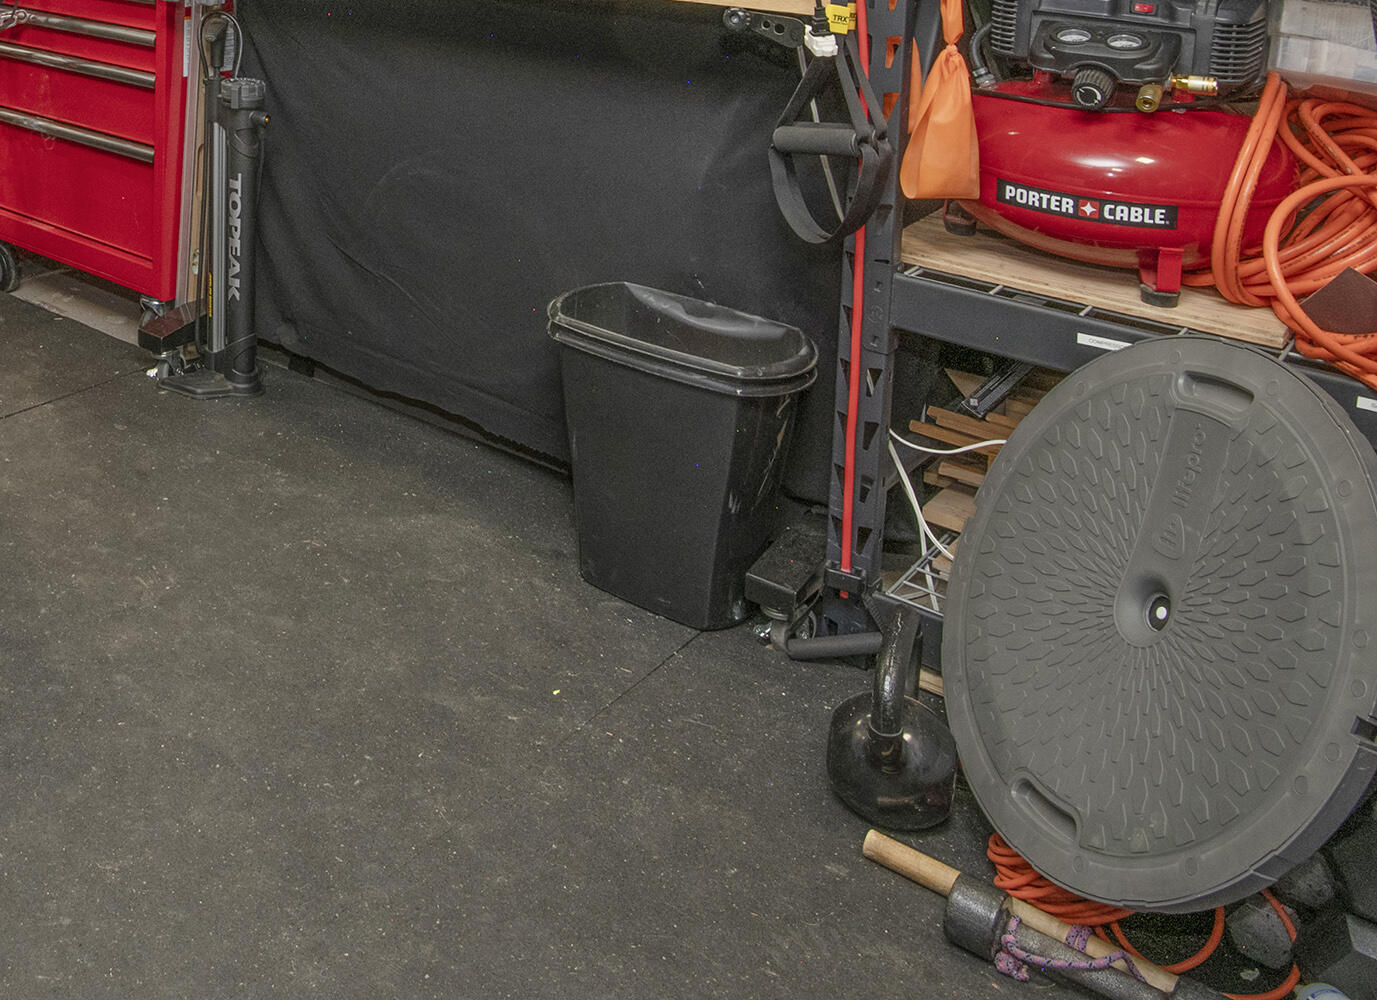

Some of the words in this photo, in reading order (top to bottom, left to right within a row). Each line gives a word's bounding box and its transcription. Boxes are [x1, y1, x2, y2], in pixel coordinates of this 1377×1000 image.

[833, 15, 848, 23] TRX
[1005, 185, 1074, 214] PORTER
[1103, 204, 1167, 225] CABLE
[228, 173, 242, 301] TOPEAK
[1173, 430, 1207, 508] lifepro
